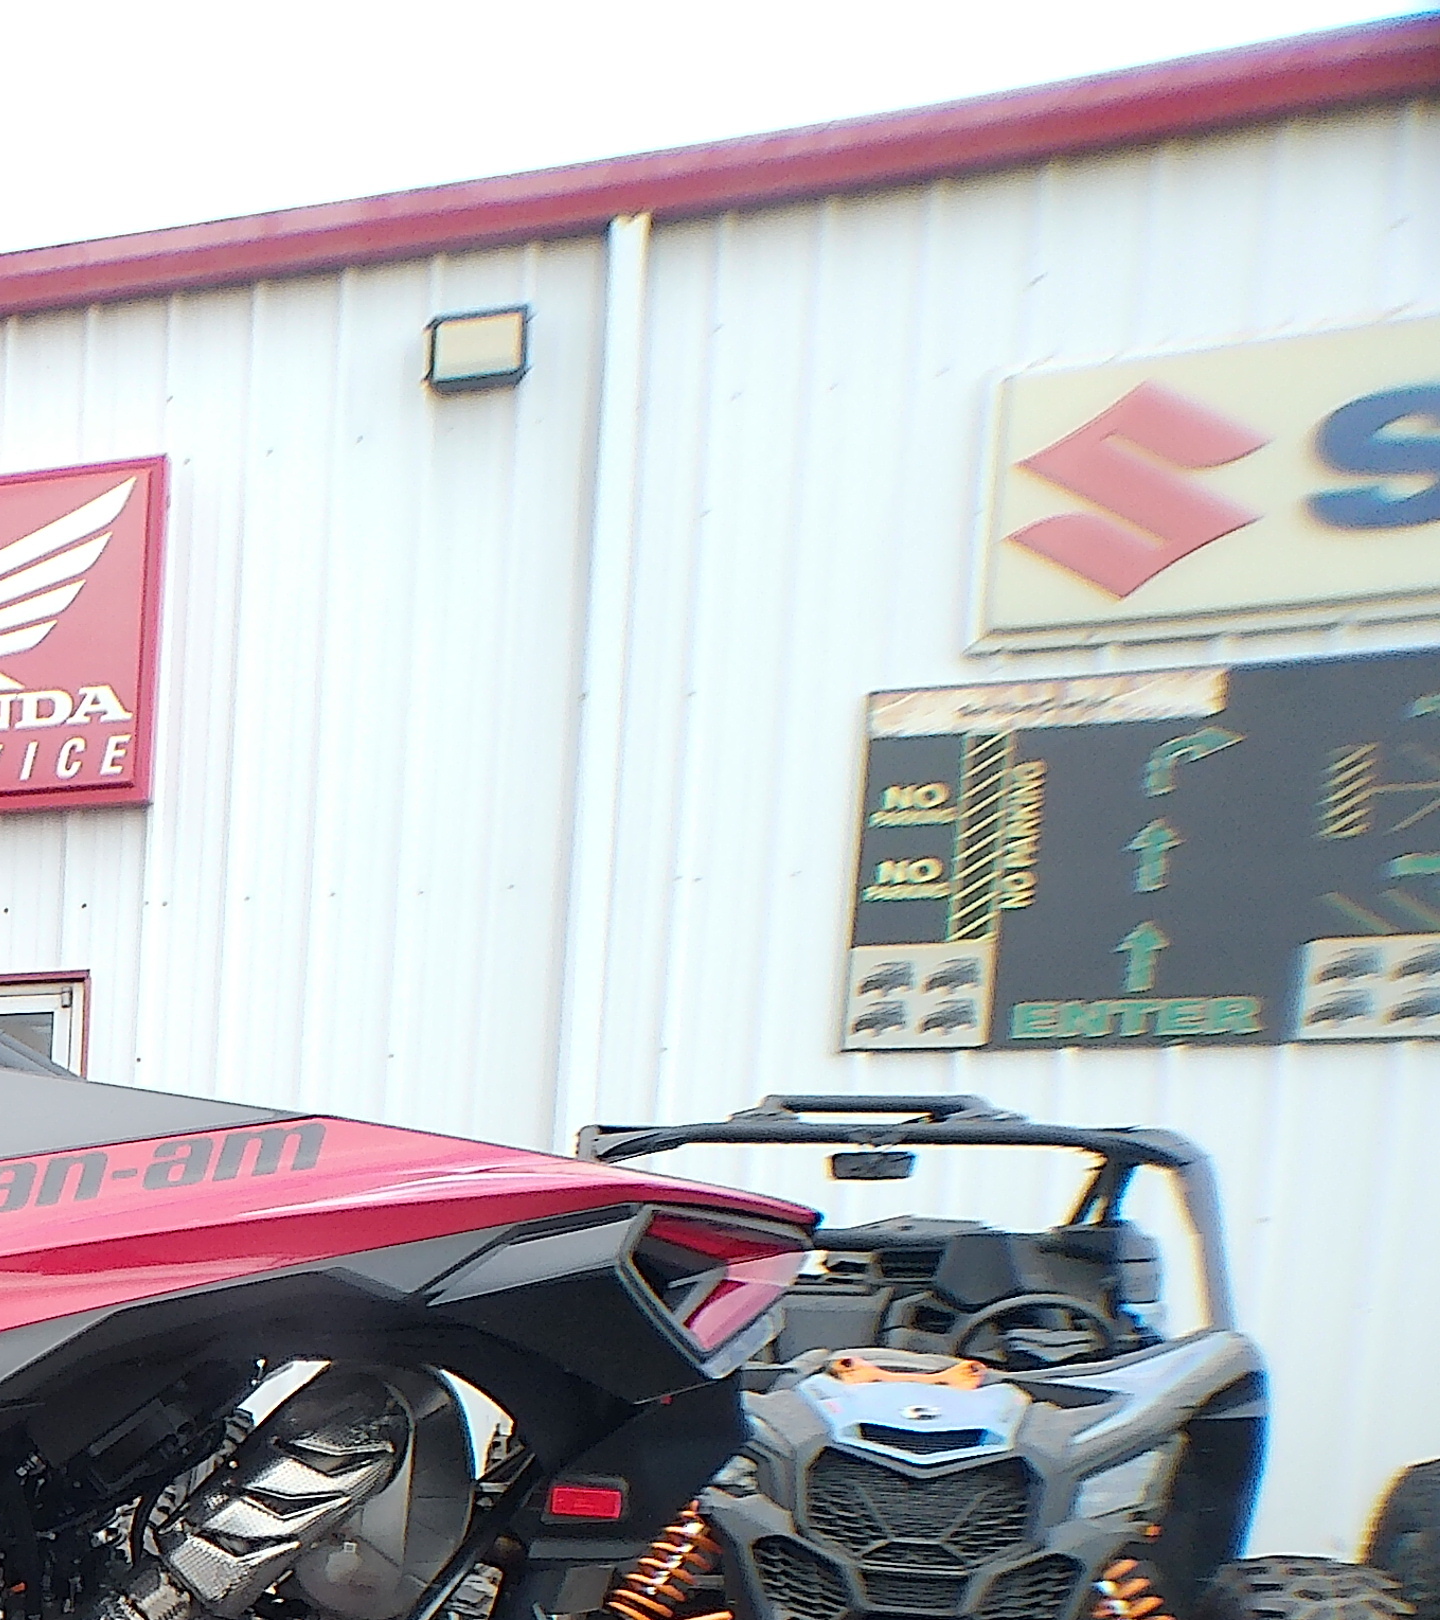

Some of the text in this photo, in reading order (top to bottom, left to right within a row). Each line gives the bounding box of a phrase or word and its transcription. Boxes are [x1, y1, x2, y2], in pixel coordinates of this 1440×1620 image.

[882, 781, 952, 811] NO
[875, 857, 944, 886] NO
[1010, 996, 1268, 1039] ENTER
